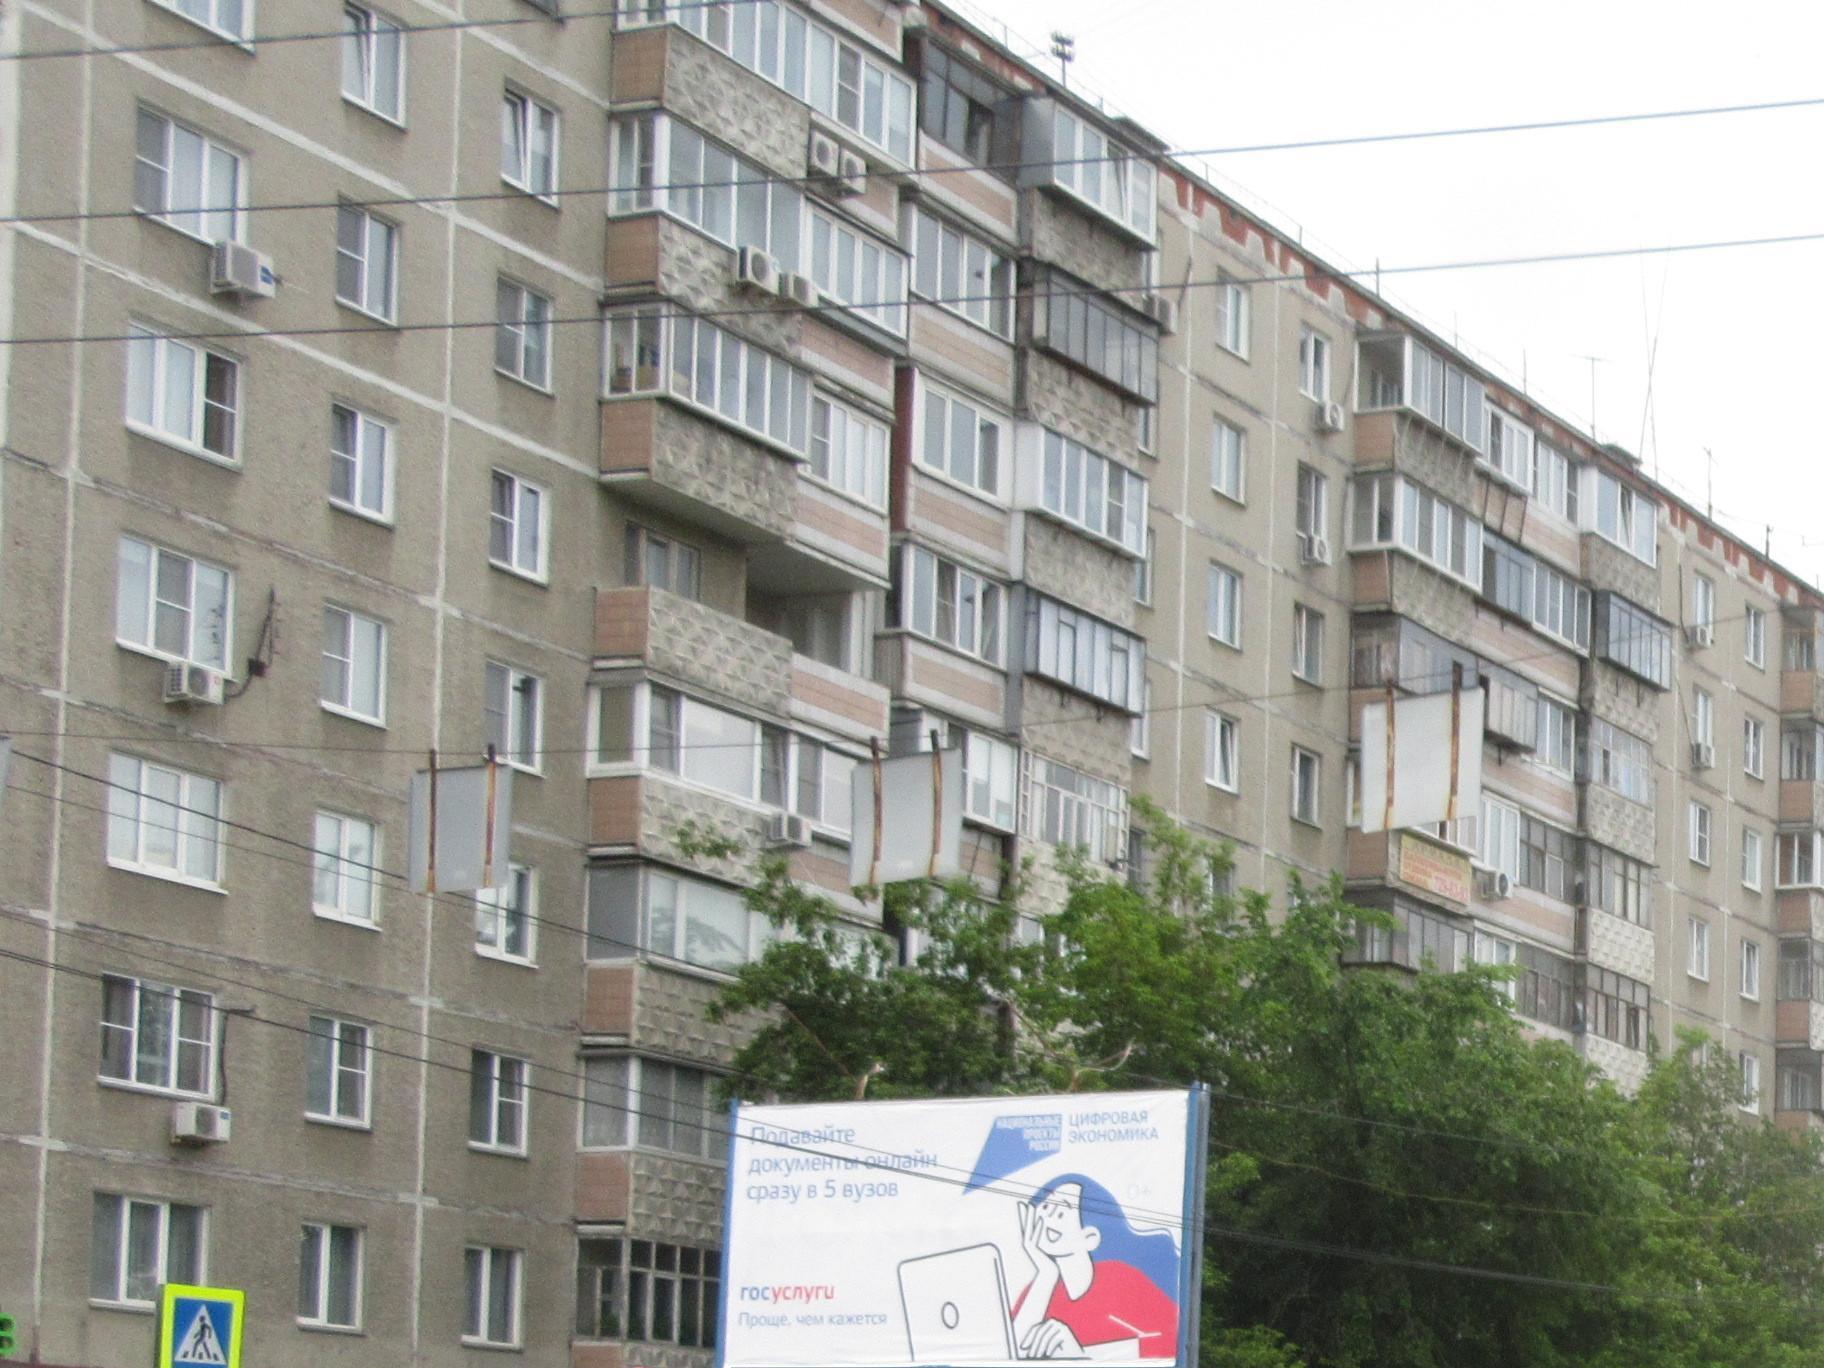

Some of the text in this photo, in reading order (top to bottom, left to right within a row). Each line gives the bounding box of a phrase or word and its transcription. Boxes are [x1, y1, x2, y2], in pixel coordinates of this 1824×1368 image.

[1068, 1110, 1149, 1128] ЦИФРОВАЯ
[751, 1124, 856, 1147] Подавайте
[1068, 1128, 1159, 1144] ЭКОНОМИКА
[748, 1150, 938, 1177] документы онлайн
[746, 1180, 898, 1205] сразу в 5 вузов
[740, 1285, 835, 1305] госуслуги
[796, 1314, 823, 1326] чем
[827, 1313, 888, 1326] кажется
